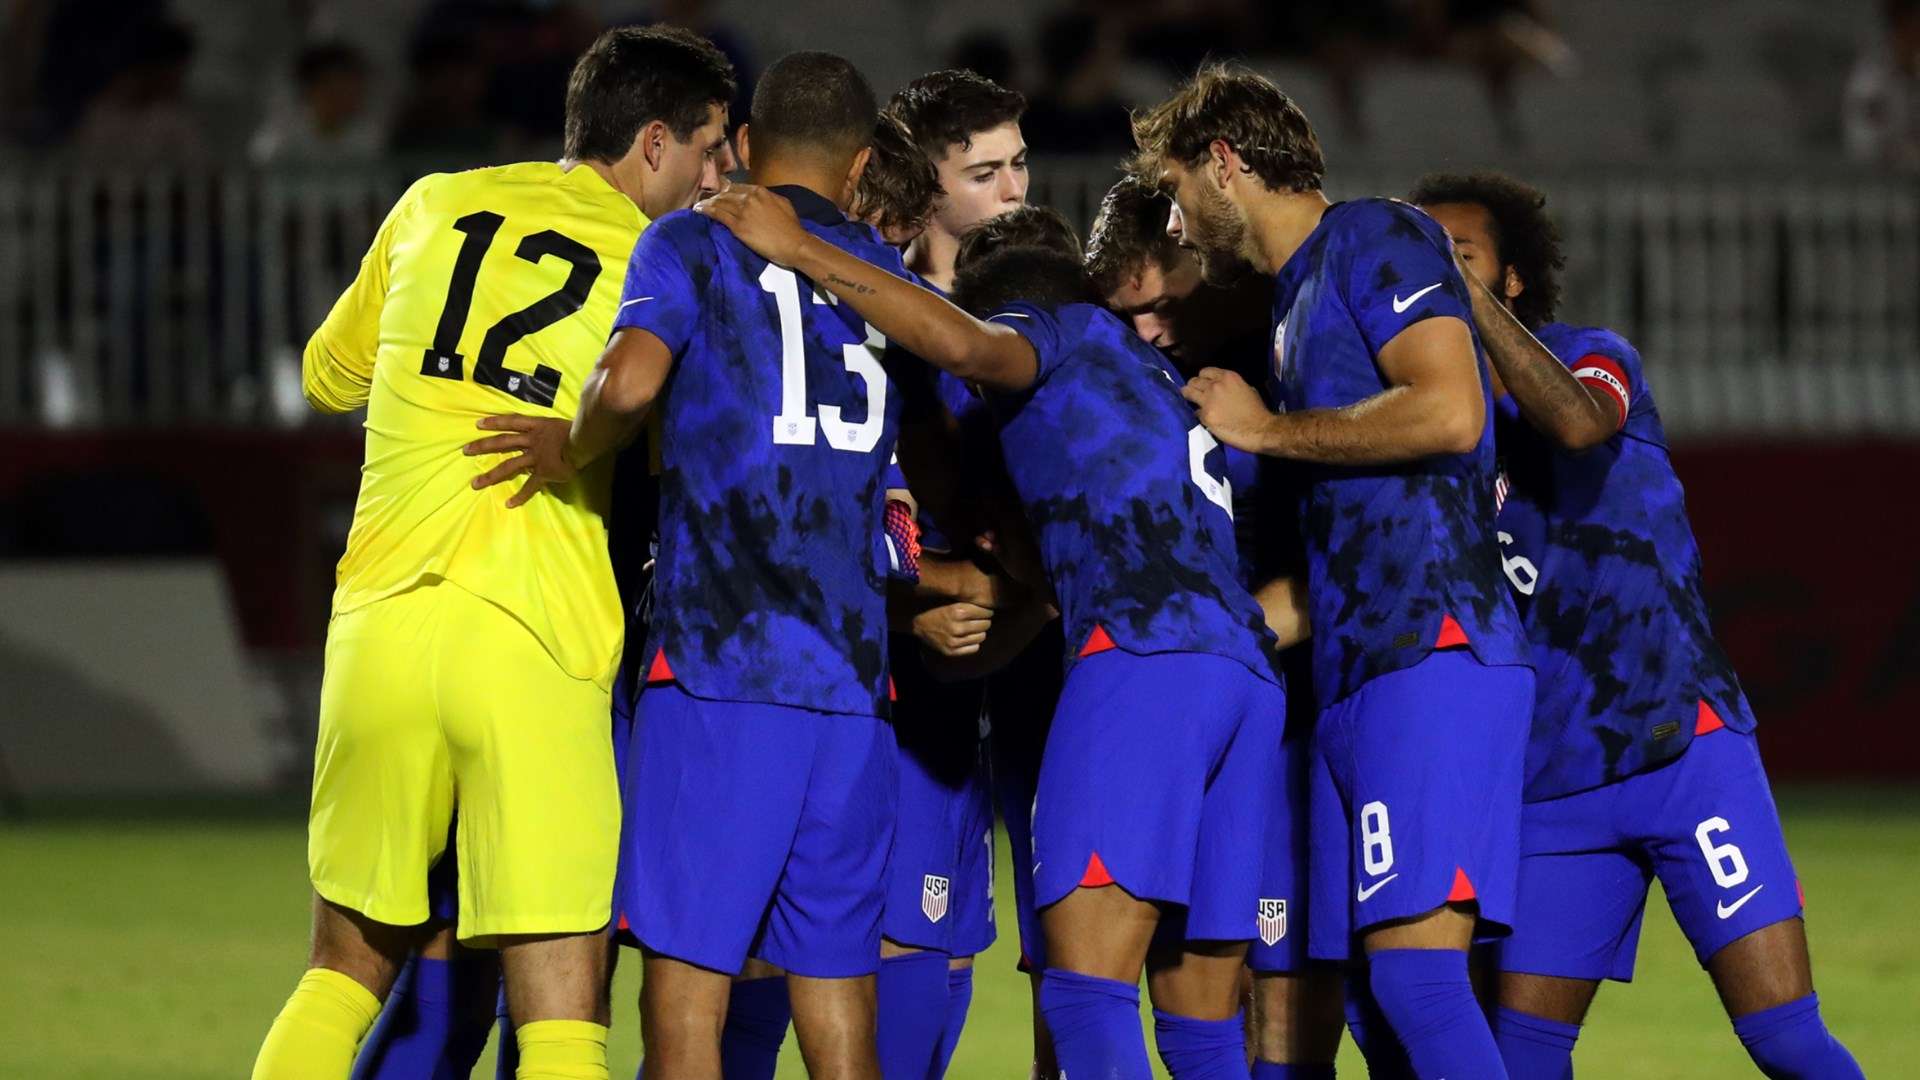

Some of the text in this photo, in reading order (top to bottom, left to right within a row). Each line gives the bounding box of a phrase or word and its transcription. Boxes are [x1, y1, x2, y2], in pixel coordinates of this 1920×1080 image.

[420, 210, 602, 407] 12
[759, 263, 887, 453] 13
[1361, 801, 1393, 876] 8
[1695, 816, 1749, 888] 6
[926, 877, 948, 896] USA
